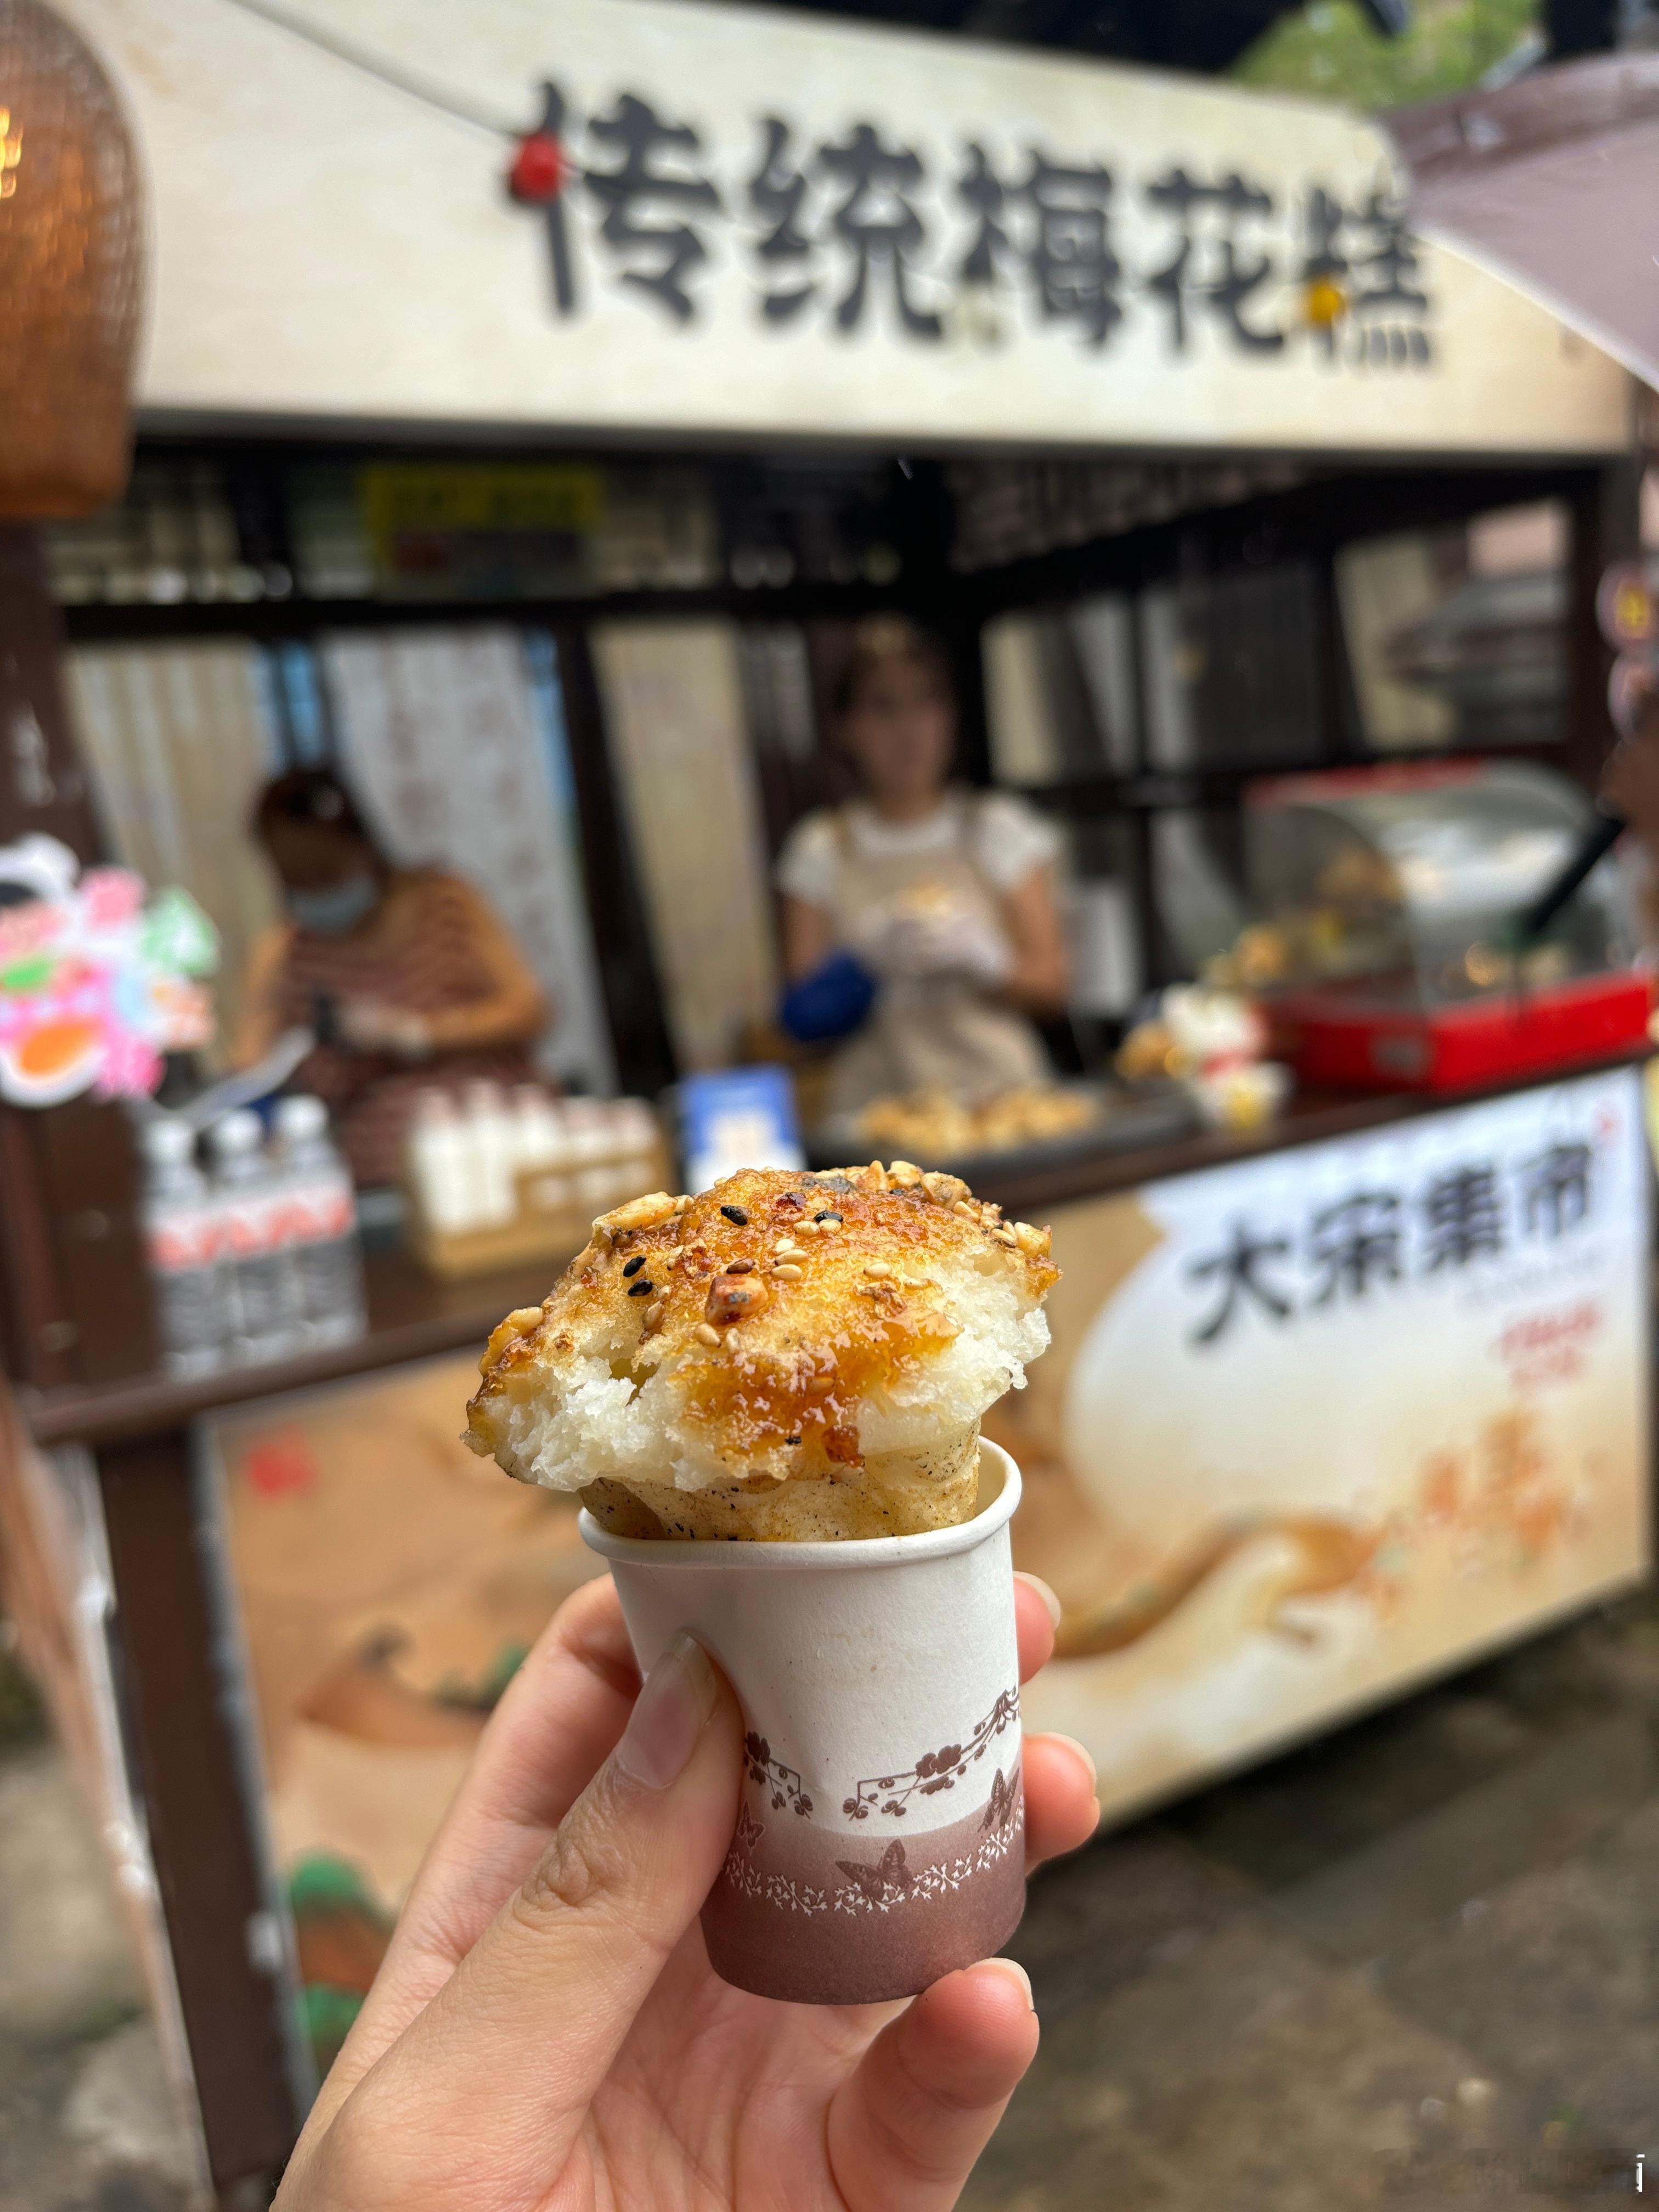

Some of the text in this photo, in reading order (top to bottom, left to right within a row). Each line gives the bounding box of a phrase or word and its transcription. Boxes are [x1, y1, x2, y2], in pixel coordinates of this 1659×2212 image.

[507, 78, 1435, 369] 传统梅花糕
